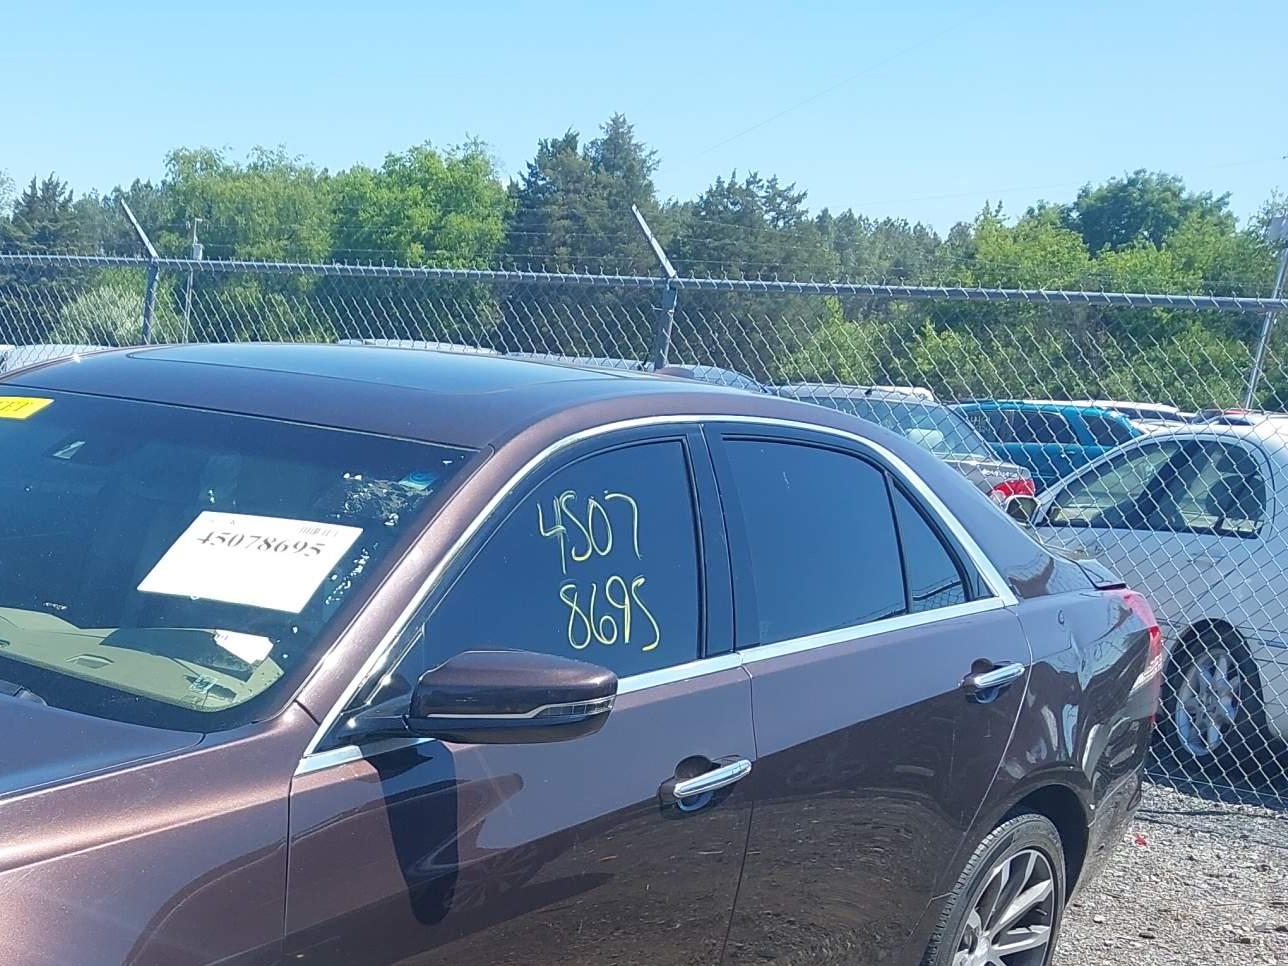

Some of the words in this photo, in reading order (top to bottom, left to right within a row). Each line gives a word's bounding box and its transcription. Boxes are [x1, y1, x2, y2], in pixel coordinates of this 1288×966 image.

[195, 530, 327, 557] 45078695
[536, 490, 643, 574] 4507
[559, 574, 661, 651] 8695
